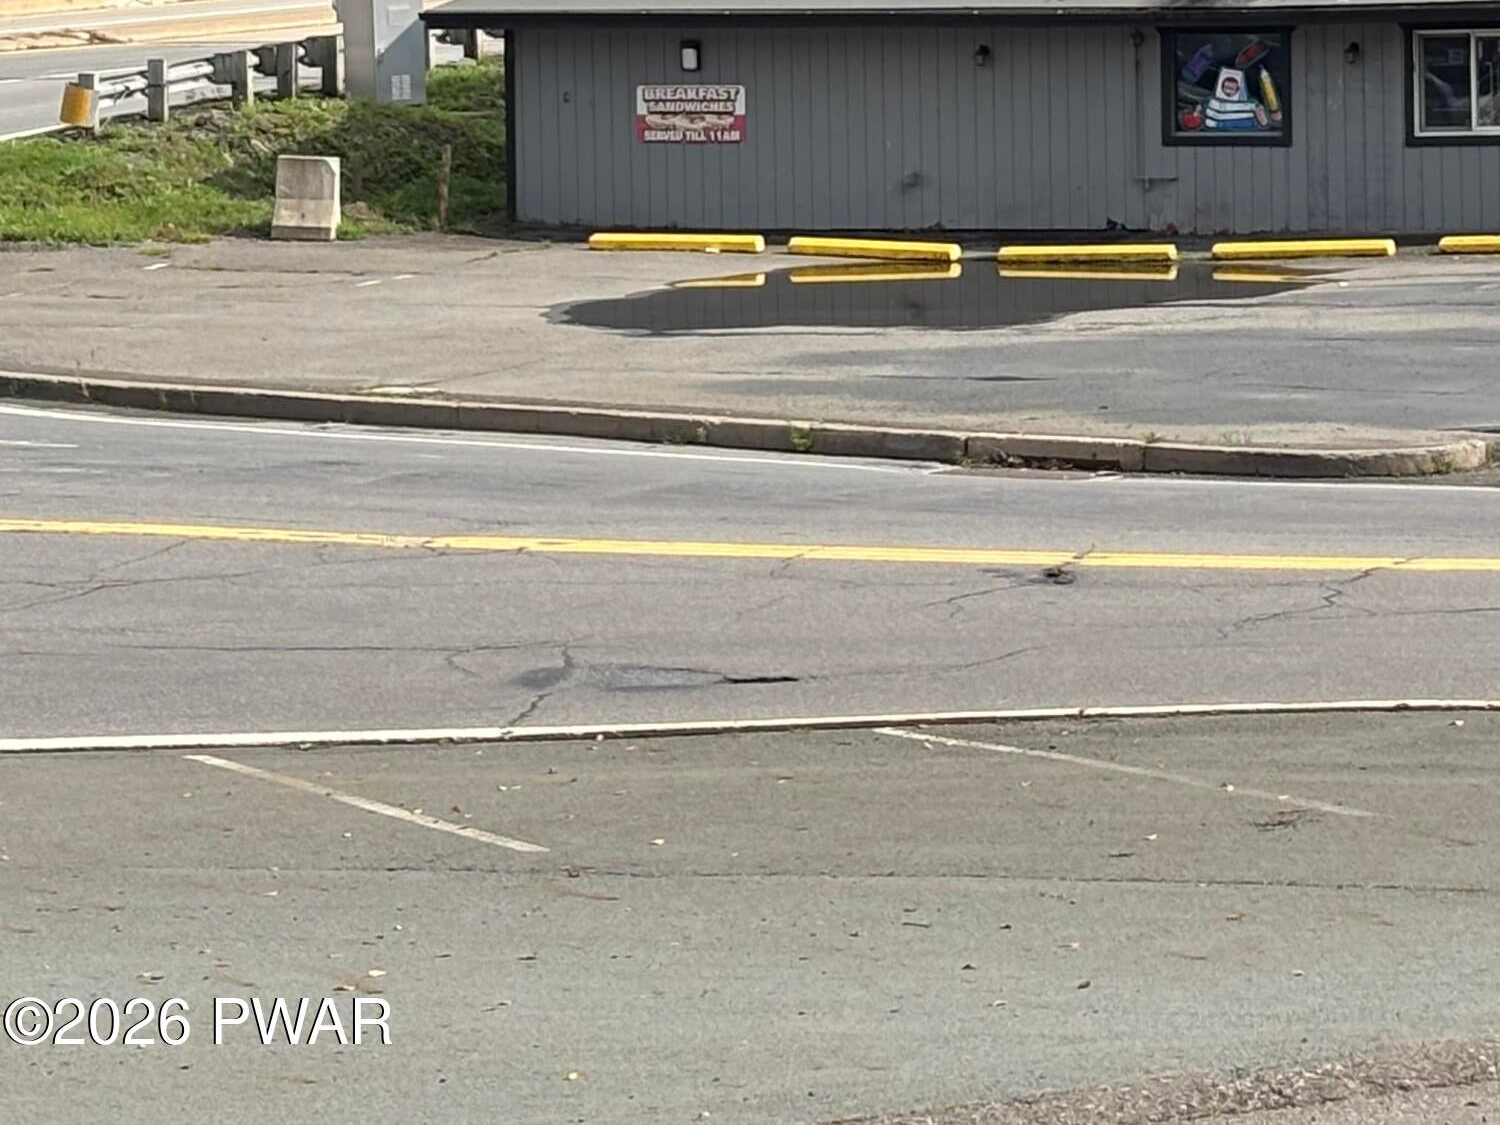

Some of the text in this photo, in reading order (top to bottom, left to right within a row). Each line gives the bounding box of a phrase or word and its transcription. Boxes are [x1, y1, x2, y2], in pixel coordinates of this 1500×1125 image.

[644, 88, 738, 100] BREAKFAST
[649, 101, 734, 112] SANDWICHES
[644, 130, 683, 141] SERVED
